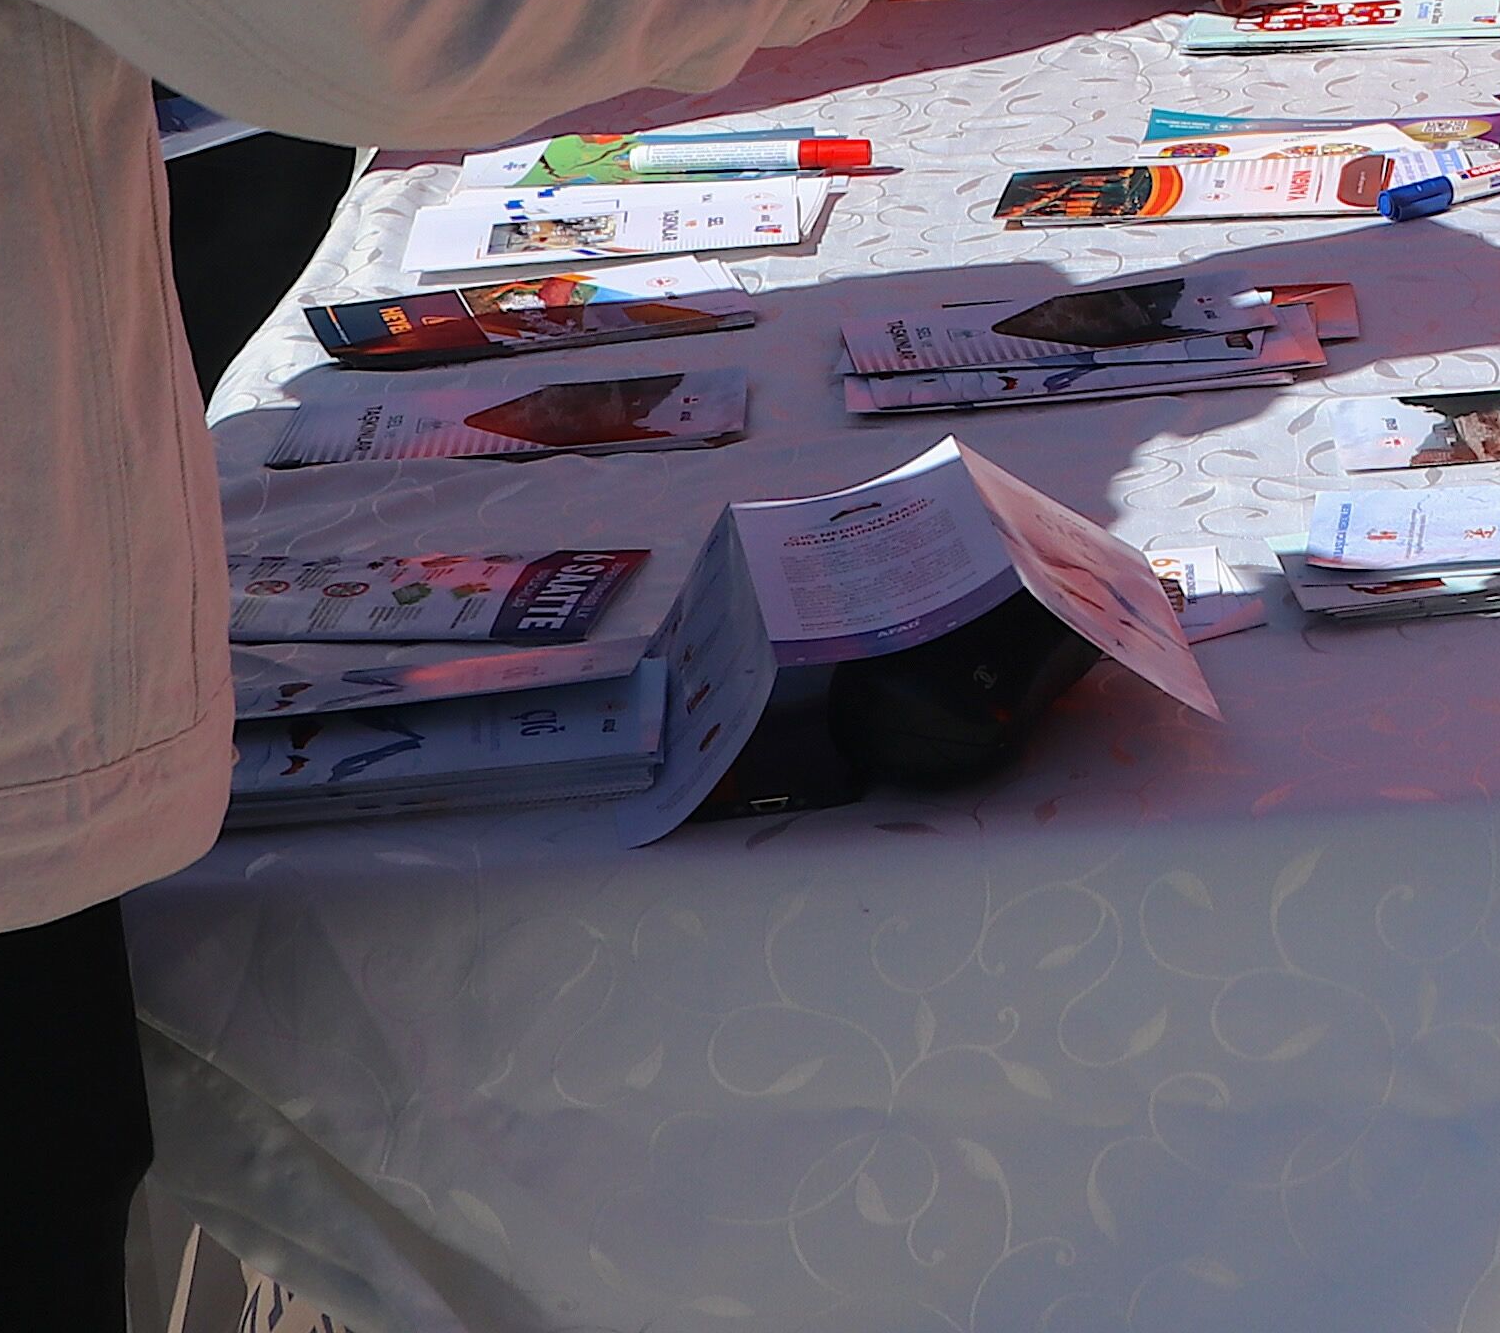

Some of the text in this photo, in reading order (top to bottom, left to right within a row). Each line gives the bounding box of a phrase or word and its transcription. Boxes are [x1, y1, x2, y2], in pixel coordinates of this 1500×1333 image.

[355, 405, 383, 451] TAŞKINLAR
[572, 554, 615, 562] 6
[517, 564, 605, 630] SAATTE
[876, 619, 920, 638] AFAD
[510, 709, 566, 737] ÇIĞ
